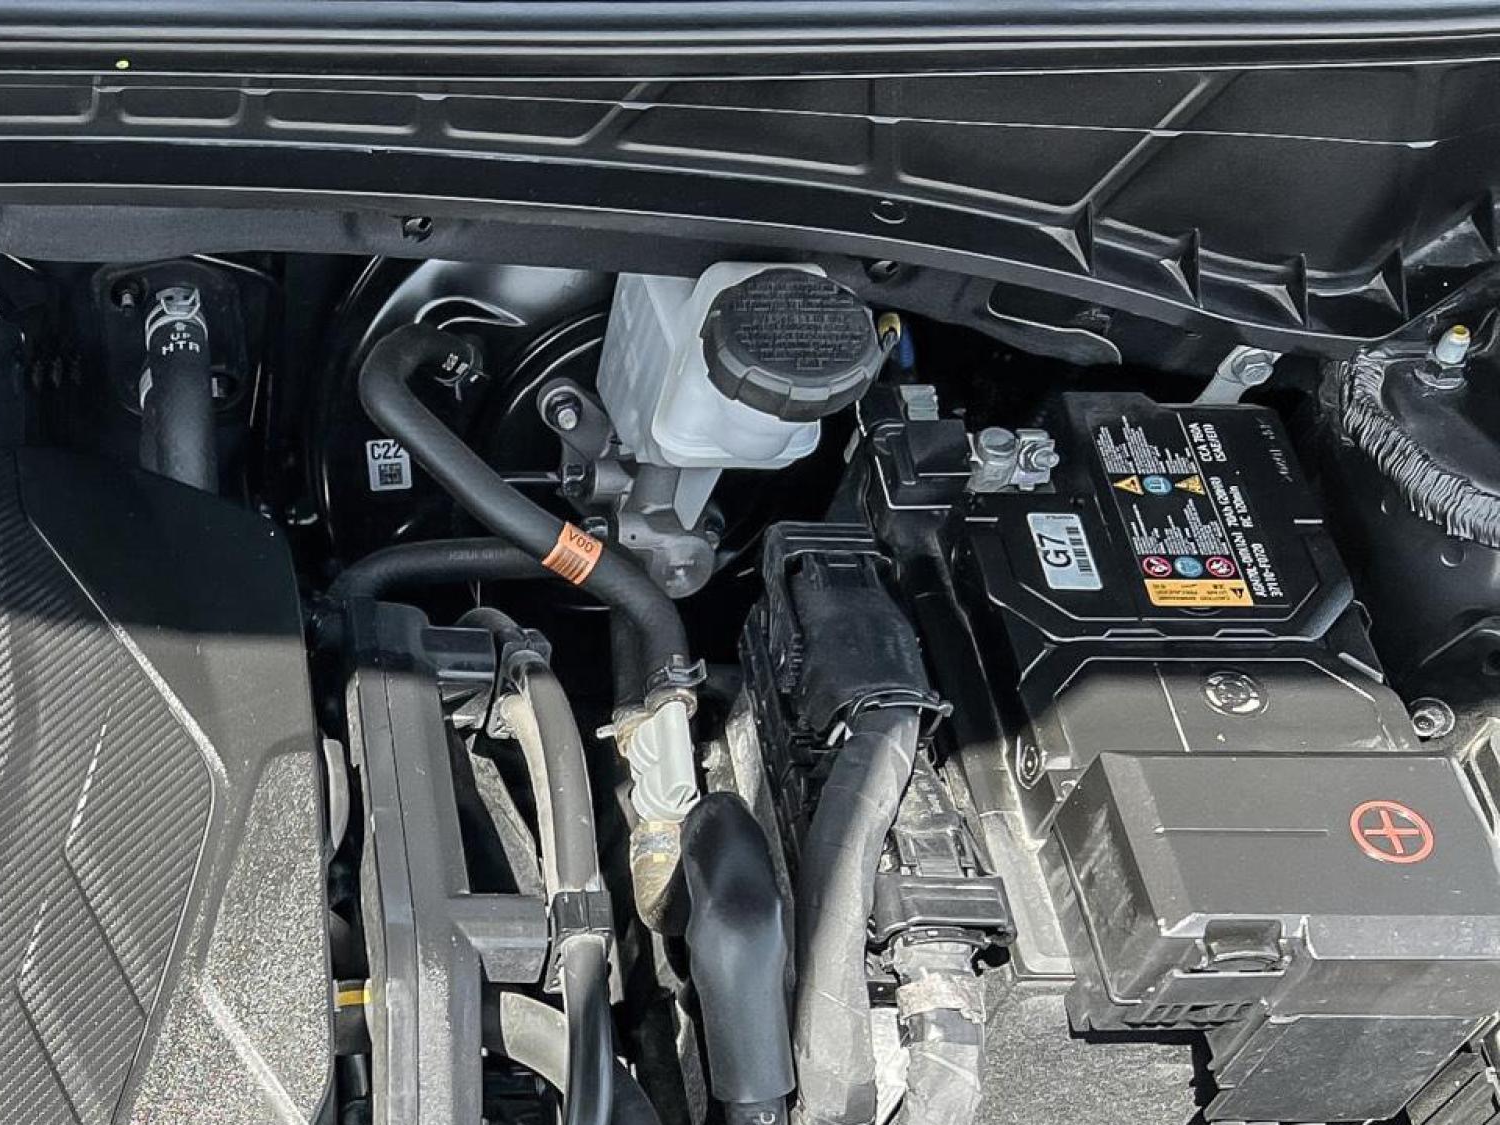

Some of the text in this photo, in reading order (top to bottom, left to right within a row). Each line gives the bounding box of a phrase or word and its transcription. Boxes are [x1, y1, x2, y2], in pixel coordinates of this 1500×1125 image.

[171, 333, 190, 341] UP
[161, 340, 200, 355] HTR
[371, 441, 403, 460] C22
[1036, 532, 1072, 567] G7
